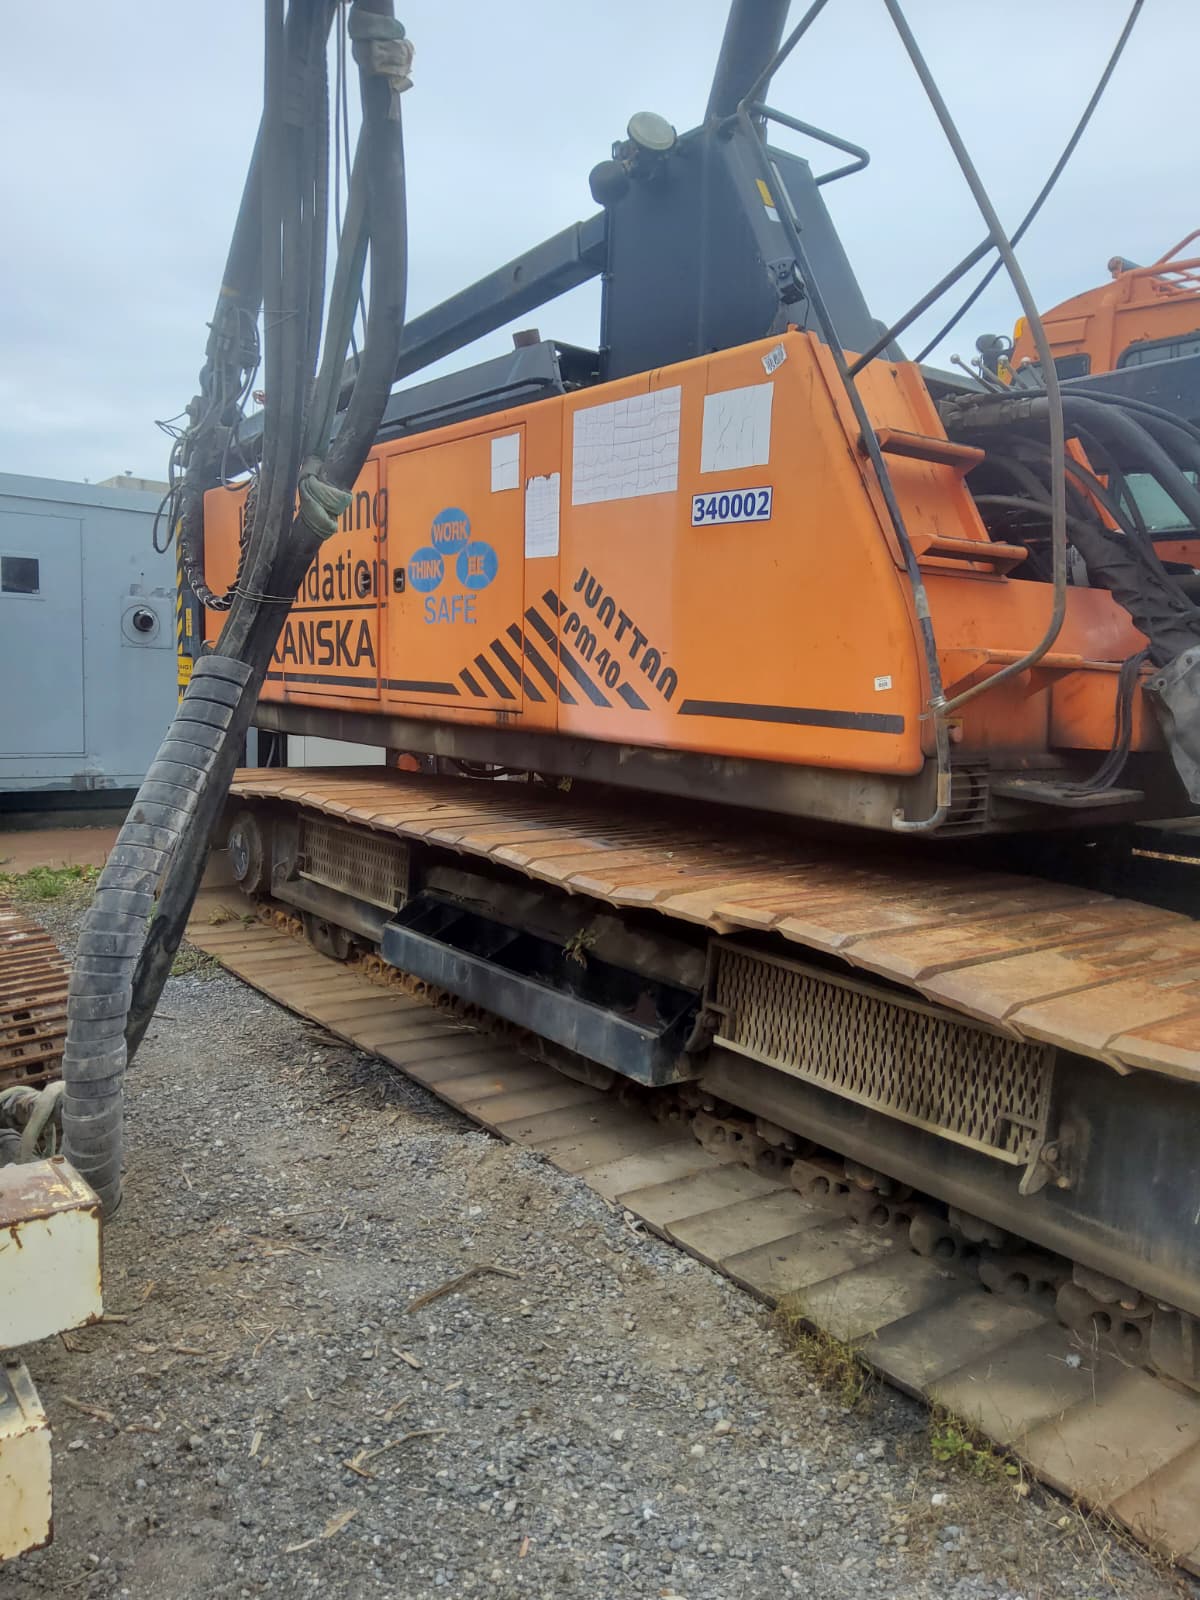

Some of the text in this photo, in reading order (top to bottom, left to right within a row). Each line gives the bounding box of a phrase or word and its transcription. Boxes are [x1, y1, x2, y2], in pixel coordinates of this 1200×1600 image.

[693, 490, 770, 522] 340002
[432, 520, 468, 543] WORK
[411, 559, 441, 580] THINK
[468, 555, 485, 575] BE
[423, 593, 478, 624] SAFE
[573, 567, 678, 702] JUNTTAN
